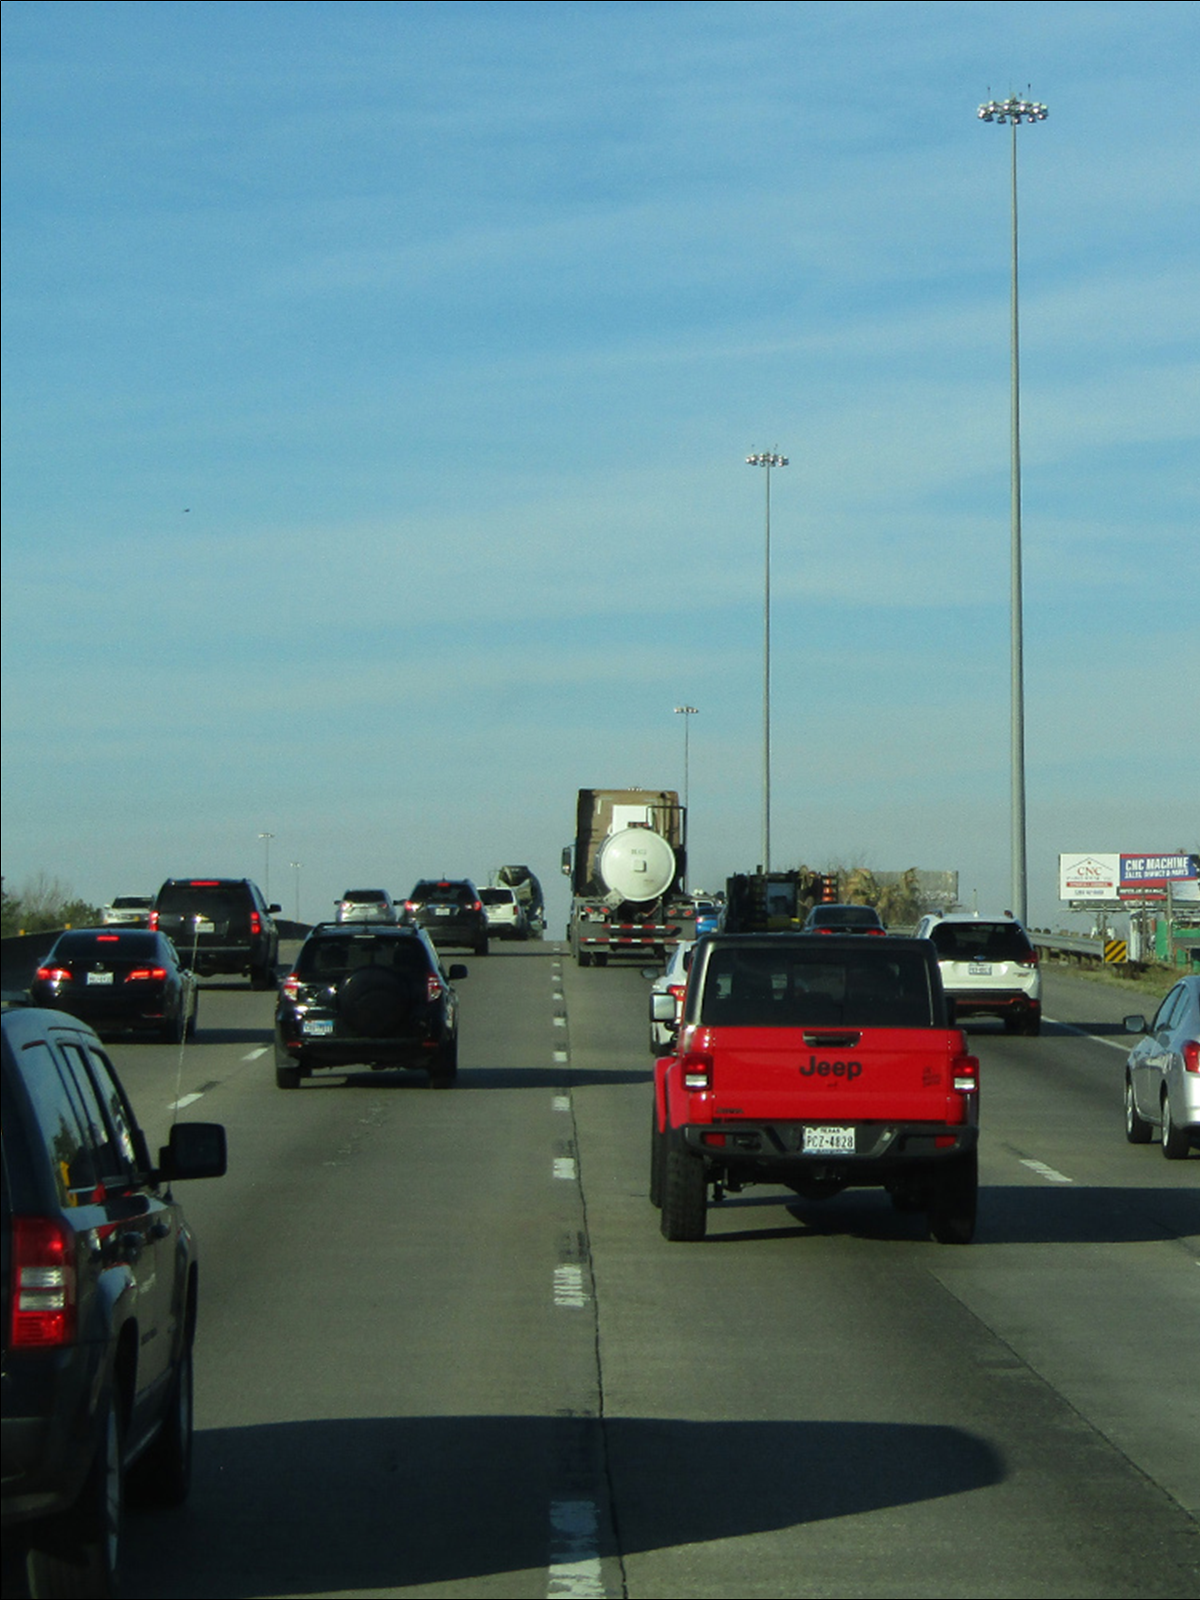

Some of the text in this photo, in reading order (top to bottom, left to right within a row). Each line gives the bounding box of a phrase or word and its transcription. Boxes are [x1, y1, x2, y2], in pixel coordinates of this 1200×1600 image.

[1125, 857, 1189, 871] CNC MACHINE
[1077, 867, 1102, 876] CNC
[800, 1056, 862, 1081] Jeep
